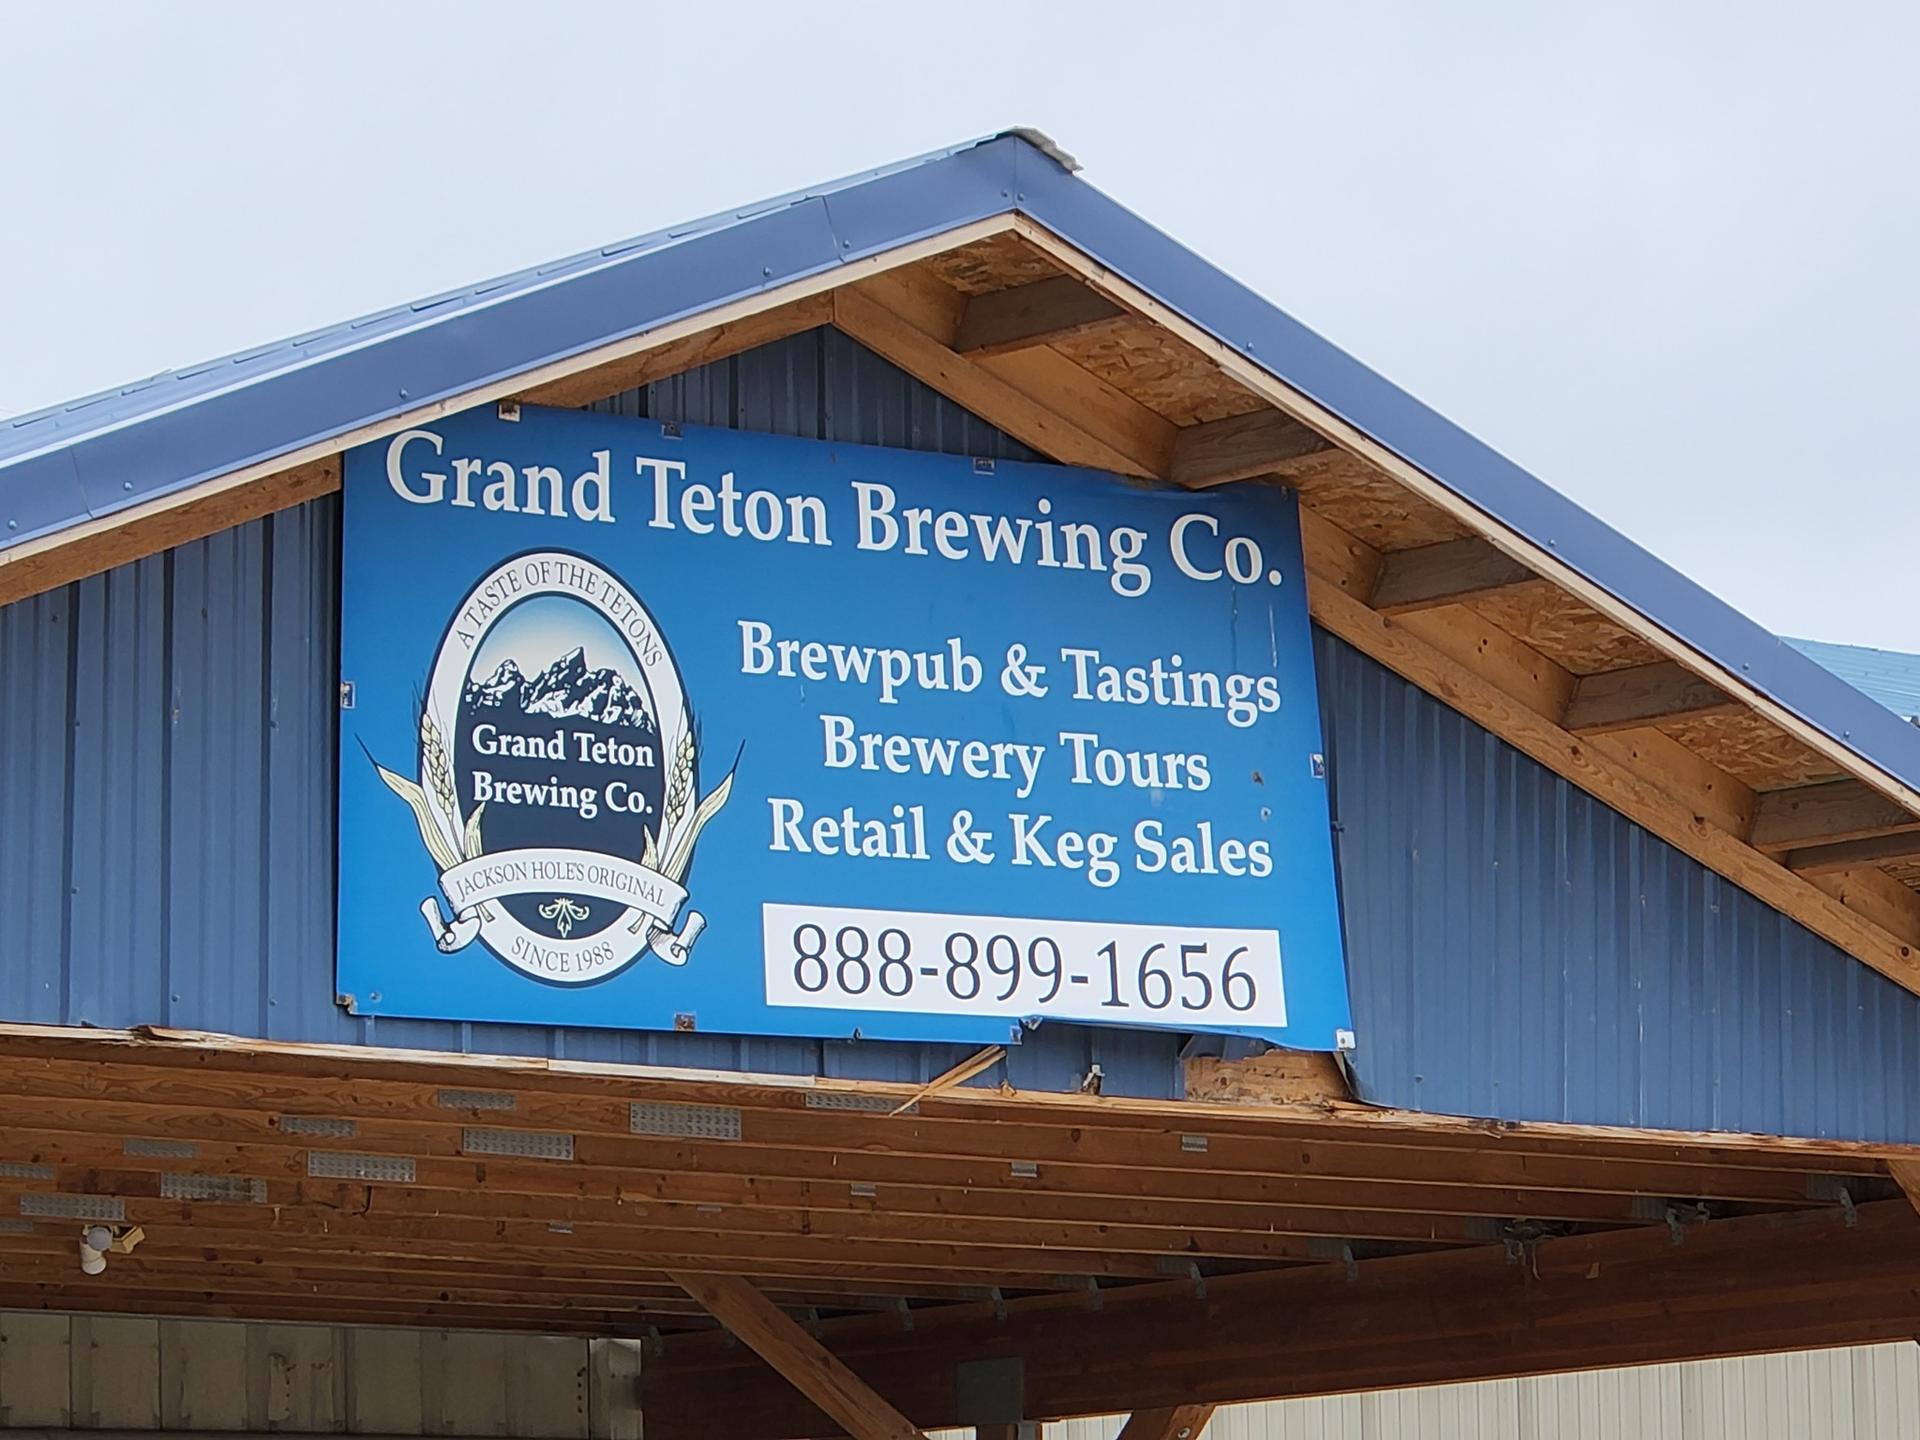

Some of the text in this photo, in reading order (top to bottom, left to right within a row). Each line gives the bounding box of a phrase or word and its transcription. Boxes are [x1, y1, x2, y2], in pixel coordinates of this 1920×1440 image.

[386, 430, 1283, 597] Grand Teton Brewing Co.
[456, 561, 663, 667] A TASTE OF THE TETONS
[737, 620, 1281, 728] Brewpub & Tastings
[471, 724, 655, 768] Grand Teton
[819, 714, 1211, 798] Brewery Tours
[472, 771, 654, 819] Brewing Co.
[456, 863, 527, 902] JACKSON
[588, 867, 666, 908] ORIGINAL
[767, 798, 1274, 888] Retail & Keg Sales
[511, 936, 616, 973] SINCE 1988
[793, 923, 1257, 1011] 888-899-1656
